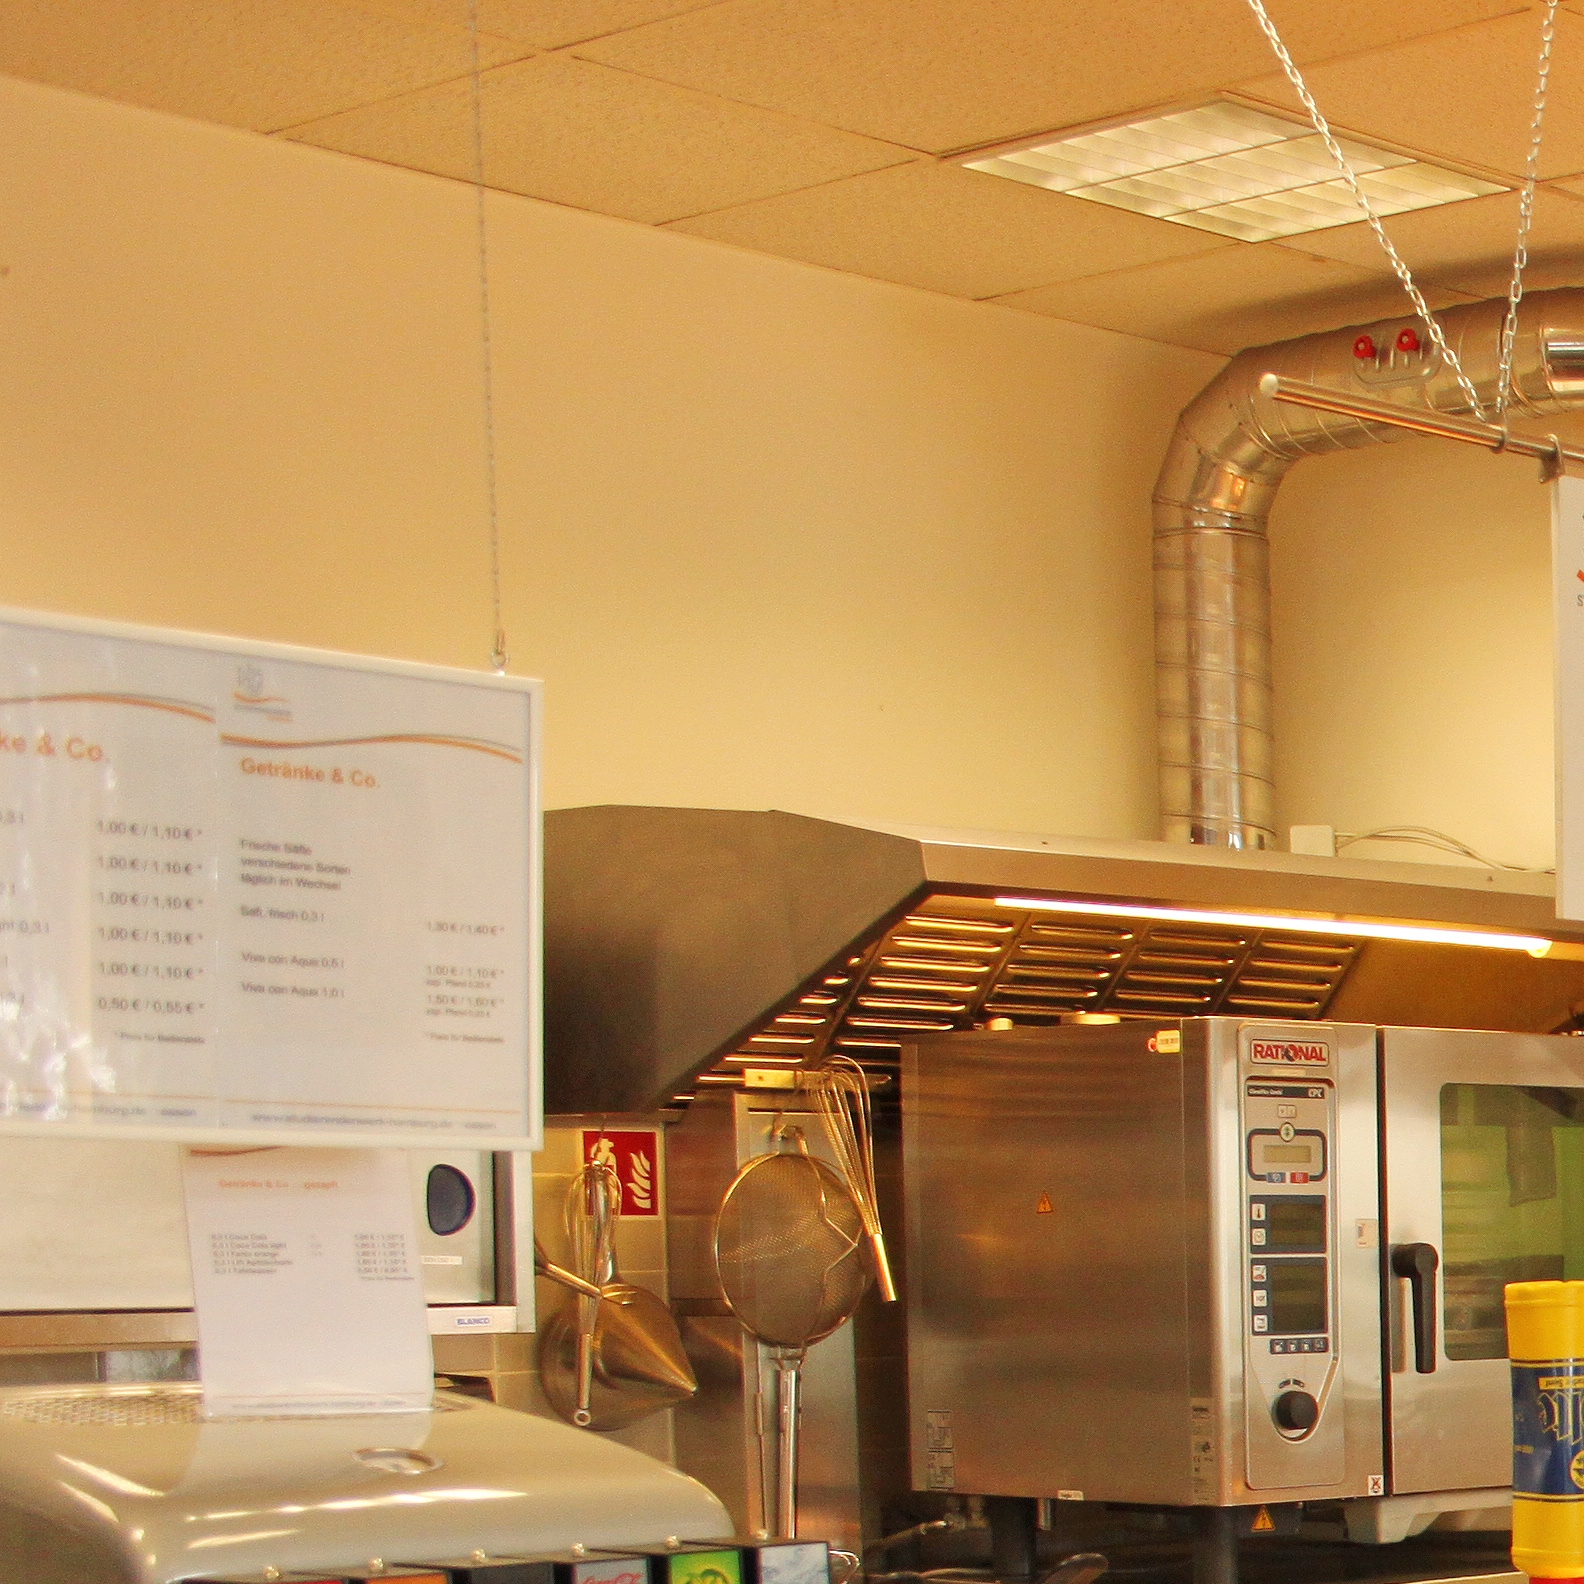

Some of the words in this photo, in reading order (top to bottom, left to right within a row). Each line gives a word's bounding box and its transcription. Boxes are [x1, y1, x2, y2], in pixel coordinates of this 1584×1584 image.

[241, 757, 325, 781] Getränke
[331, 767, 344, 784] &
[352, 769, 380, 788] Co.
[1253, 1044, 1326, 1062] RATIONAL
